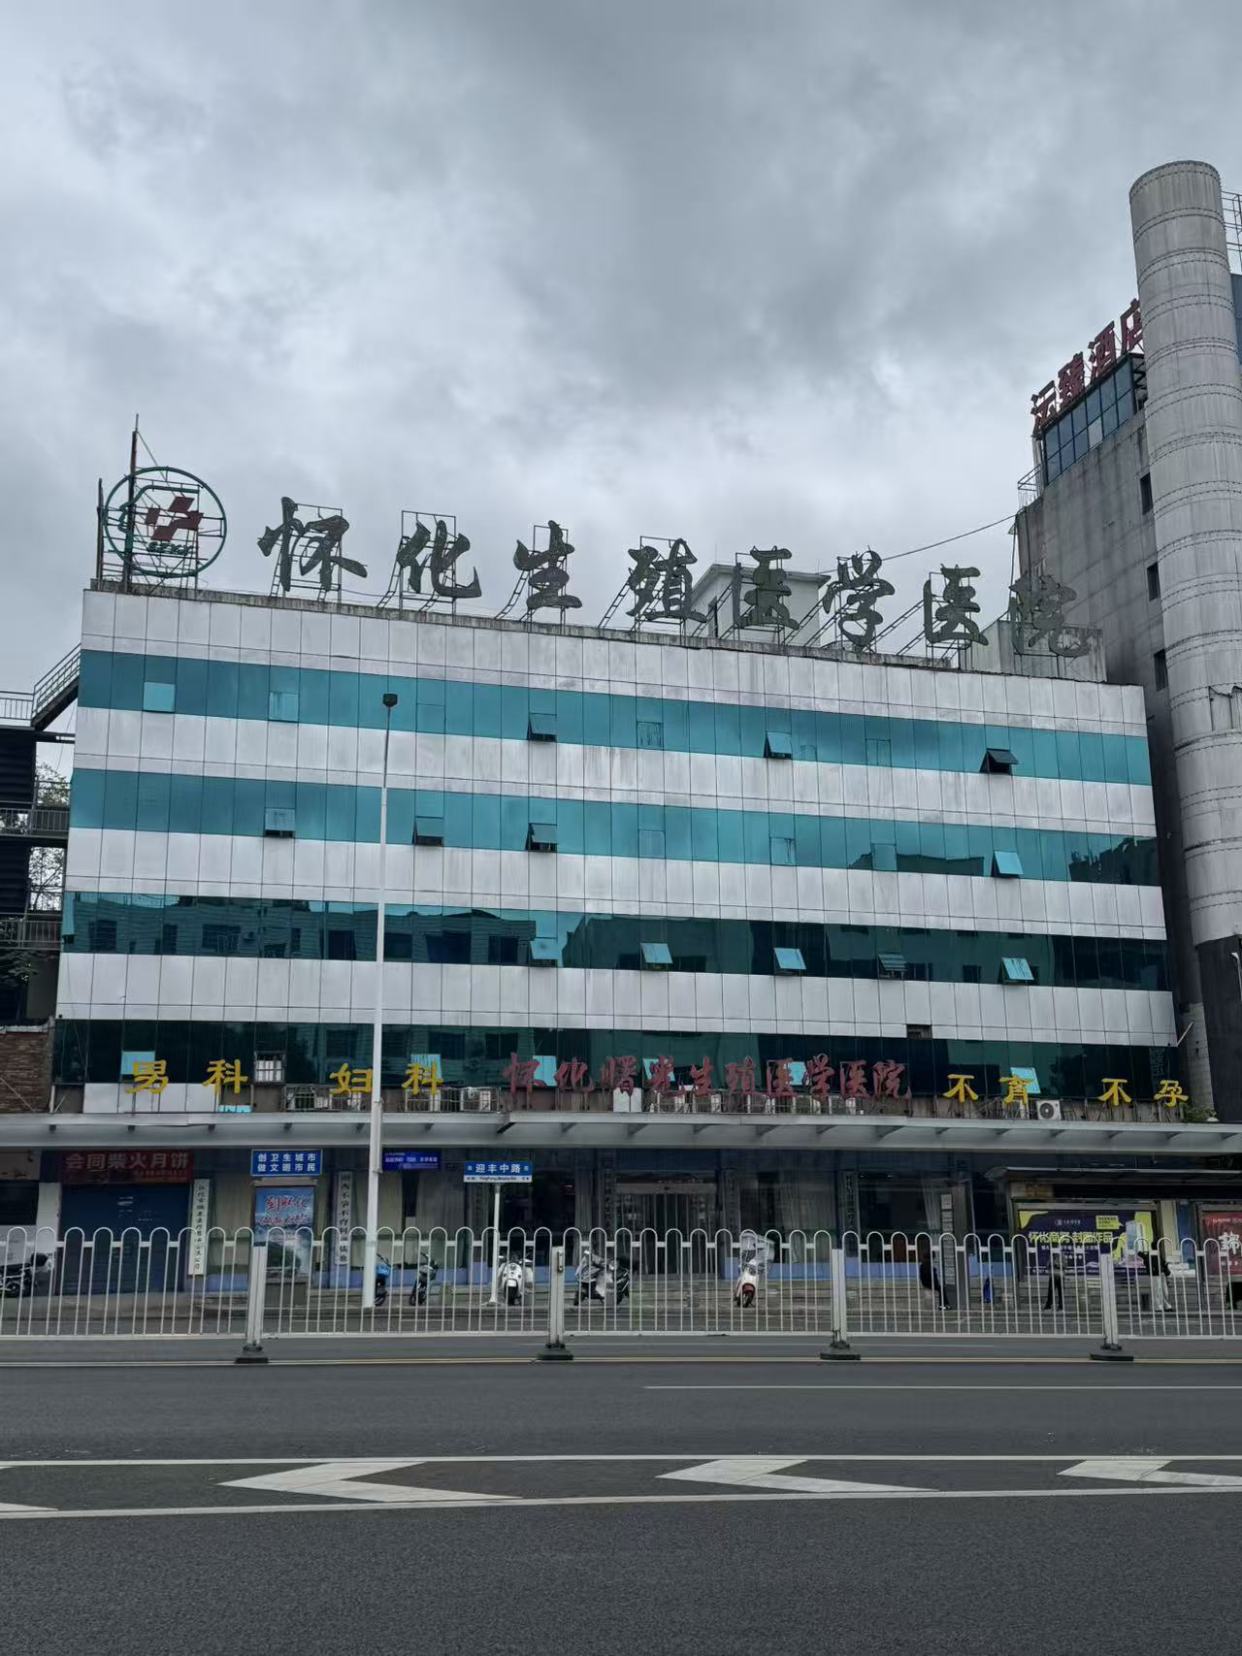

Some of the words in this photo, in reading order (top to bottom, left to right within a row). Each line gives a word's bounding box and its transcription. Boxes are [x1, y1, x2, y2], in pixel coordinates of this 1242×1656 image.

[257, 496, 1091, 658] 怀化生殖医学医院
[127, 1059, 248, 1094] 男科
[330, 1062, 443, 1097] 妇科
[503, 1052, 911, 1099] 怀化曙光生殖医学医院
[943, 1074, 1031, 1106] 不育
[1098, 1077, 1189, 1107] 不孕
[65, 1152, 189, 1169] 会同柴火月饼
[475, 1163, 521, 1174] 迎丰中路
